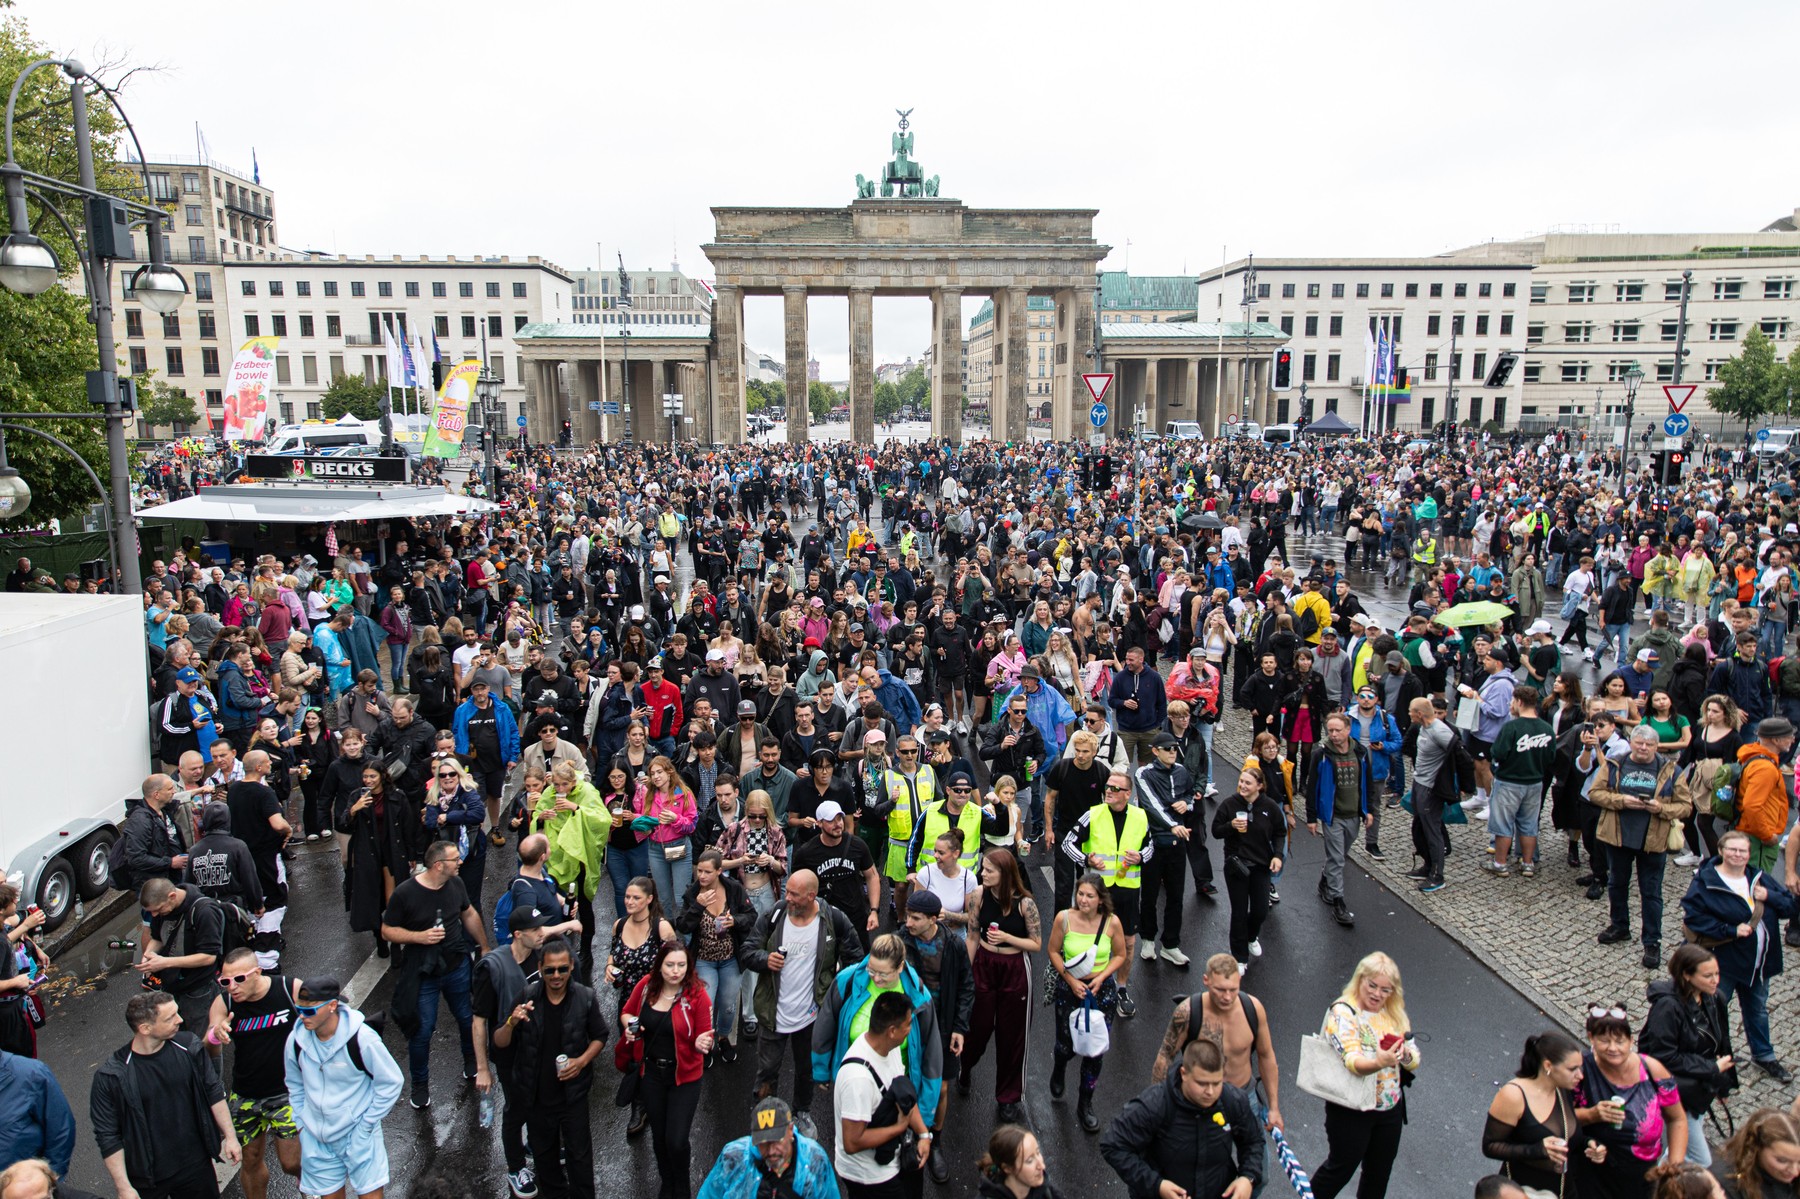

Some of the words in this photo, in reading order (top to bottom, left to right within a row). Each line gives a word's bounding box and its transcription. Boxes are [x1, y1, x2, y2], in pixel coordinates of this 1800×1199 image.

[234, 361, 273, 370] Erdbeer-
[235, 371, 269, 380] bowle
[437, 412, 463, 432] Faß
[311, 462, 375, 476] BECK'S
[786, 942, 809, 955] NIKE
[757, 1109, 776, 1130] W
